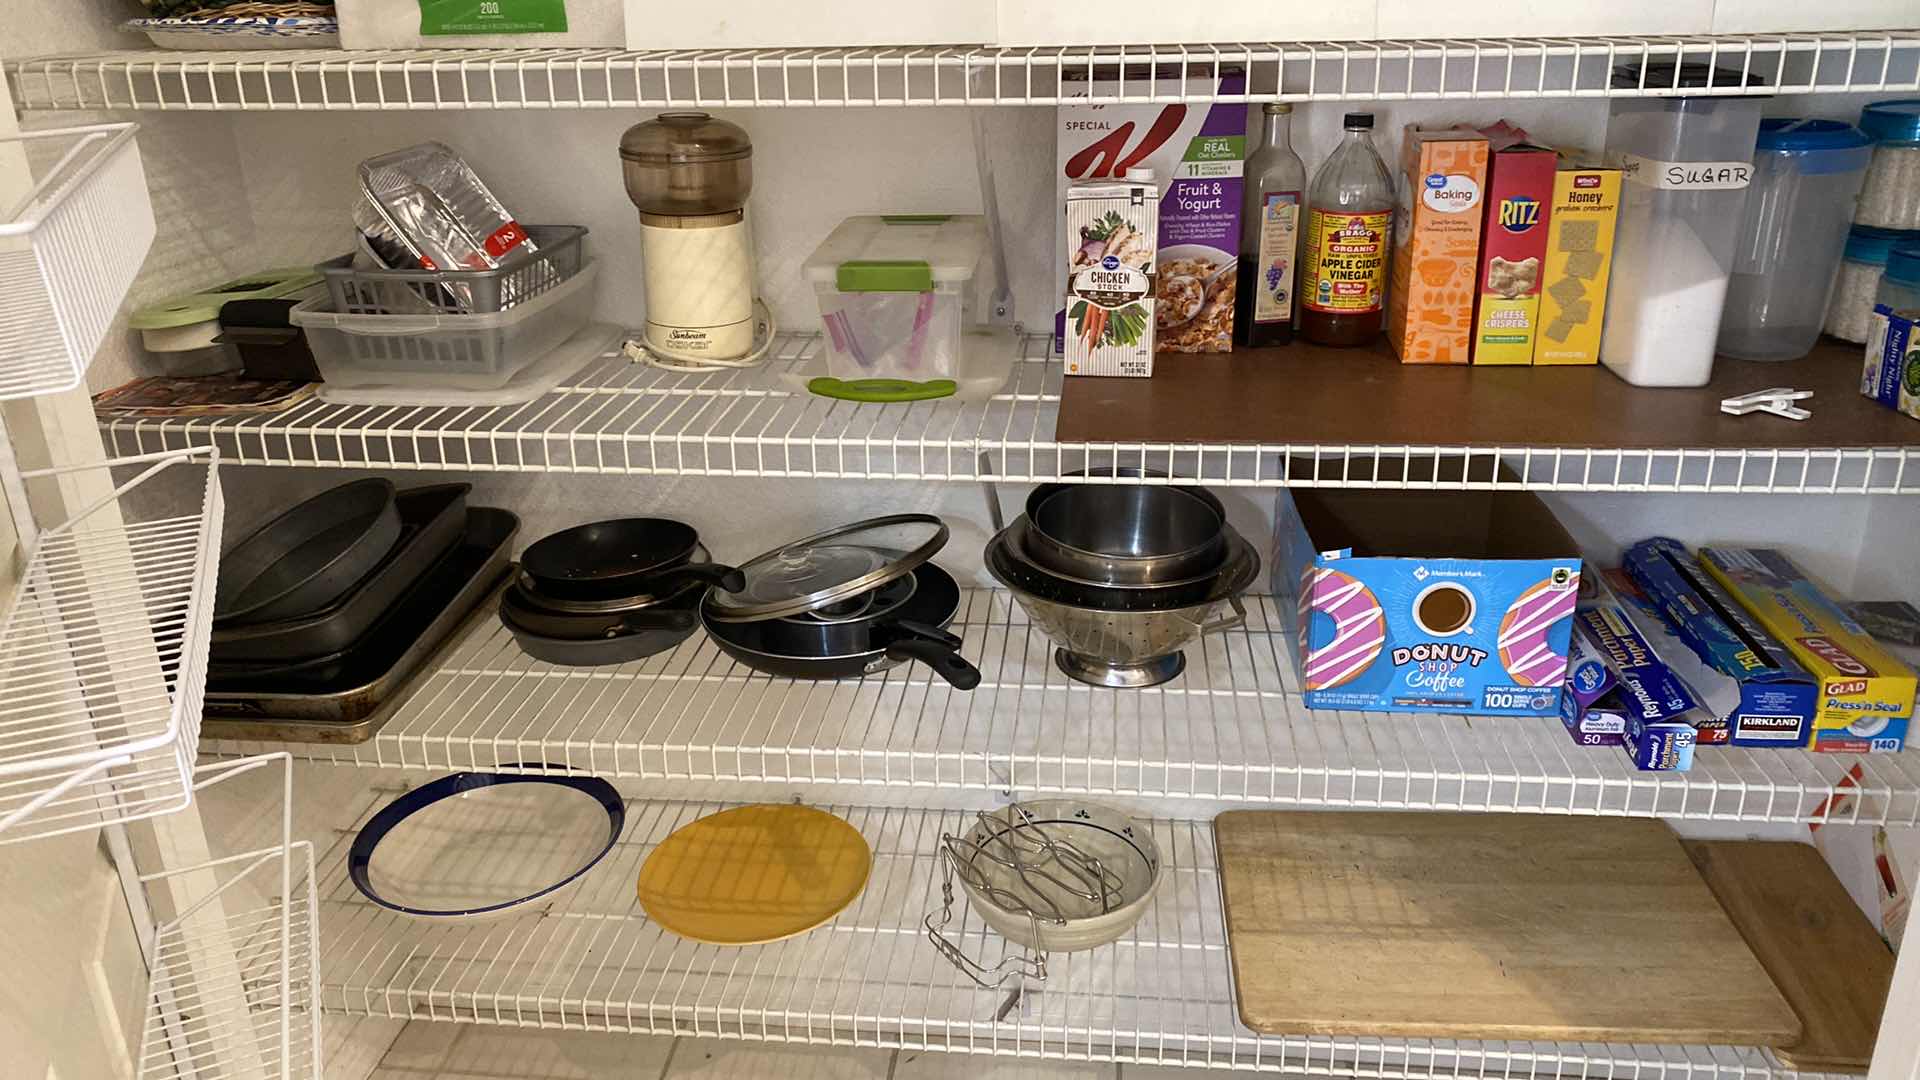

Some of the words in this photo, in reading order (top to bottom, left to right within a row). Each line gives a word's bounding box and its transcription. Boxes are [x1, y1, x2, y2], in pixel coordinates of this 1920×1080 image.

[480, 2, 499, 14] 200
[1066, 121, 1111, 130] SPECIAL
[1203, 143, 1231, 152] REAL
[1188, 164, 1199, 176] 11
[1666, 166, 1749, 185] SUGAR
[1178, 183, 1209, 196] Fruit
[1212, 182, 1222, 196] &
[1434, 189, 1473, 201] Baking
[1568, 192, 1603, 204] Honey
[1177, 197, 1221, 212] Yogurt
[1498, 200, 1542, 226] RITZ
[503, 231, 516, 243] 2
[1321, 258, 1353, 269] APPLE
[1355, 258, 1382, 269] CIDER
[1091, 271, 1130, 284] CHICKEN
[1329, 270, 1374, 280] VINEGAR
[1490, 310, 1526, 320] CHEESE
[1484, 319, 1529, 329] CRISPERS
[669, 329, 707, 339] Sunbeam
[1889, 330, 1902, 362] Nighty
[1885, 366, 1896, 395] Night
[1392, 643, 1489, 668] DONUT
[1620, 637, 1652, 667] Paper
[1806, 638, 1868, 674] GLAD
[1419, 662, 1458, 672] SHOP
[1406, 670, 1466, 692] Coffee
[1827, 682, 1866, 695] GLAD
[1485, 694, 1513, 708] 100
[1629, 679, 1663, 719] Reynolds
[1667, 698, 1686, 711] 45
[1826, 698, 1872, 711] Press'n
[1874, 702, 1903, 712] Seal
[1743, 717, 1798, 726] KIRKLAND
[1583, 734, 1601, 744] 50
[1675, 732, 1692, 748] 45
[1712, 729, 1729, 739] 75
[1873, 739, 1897, 749] 140
